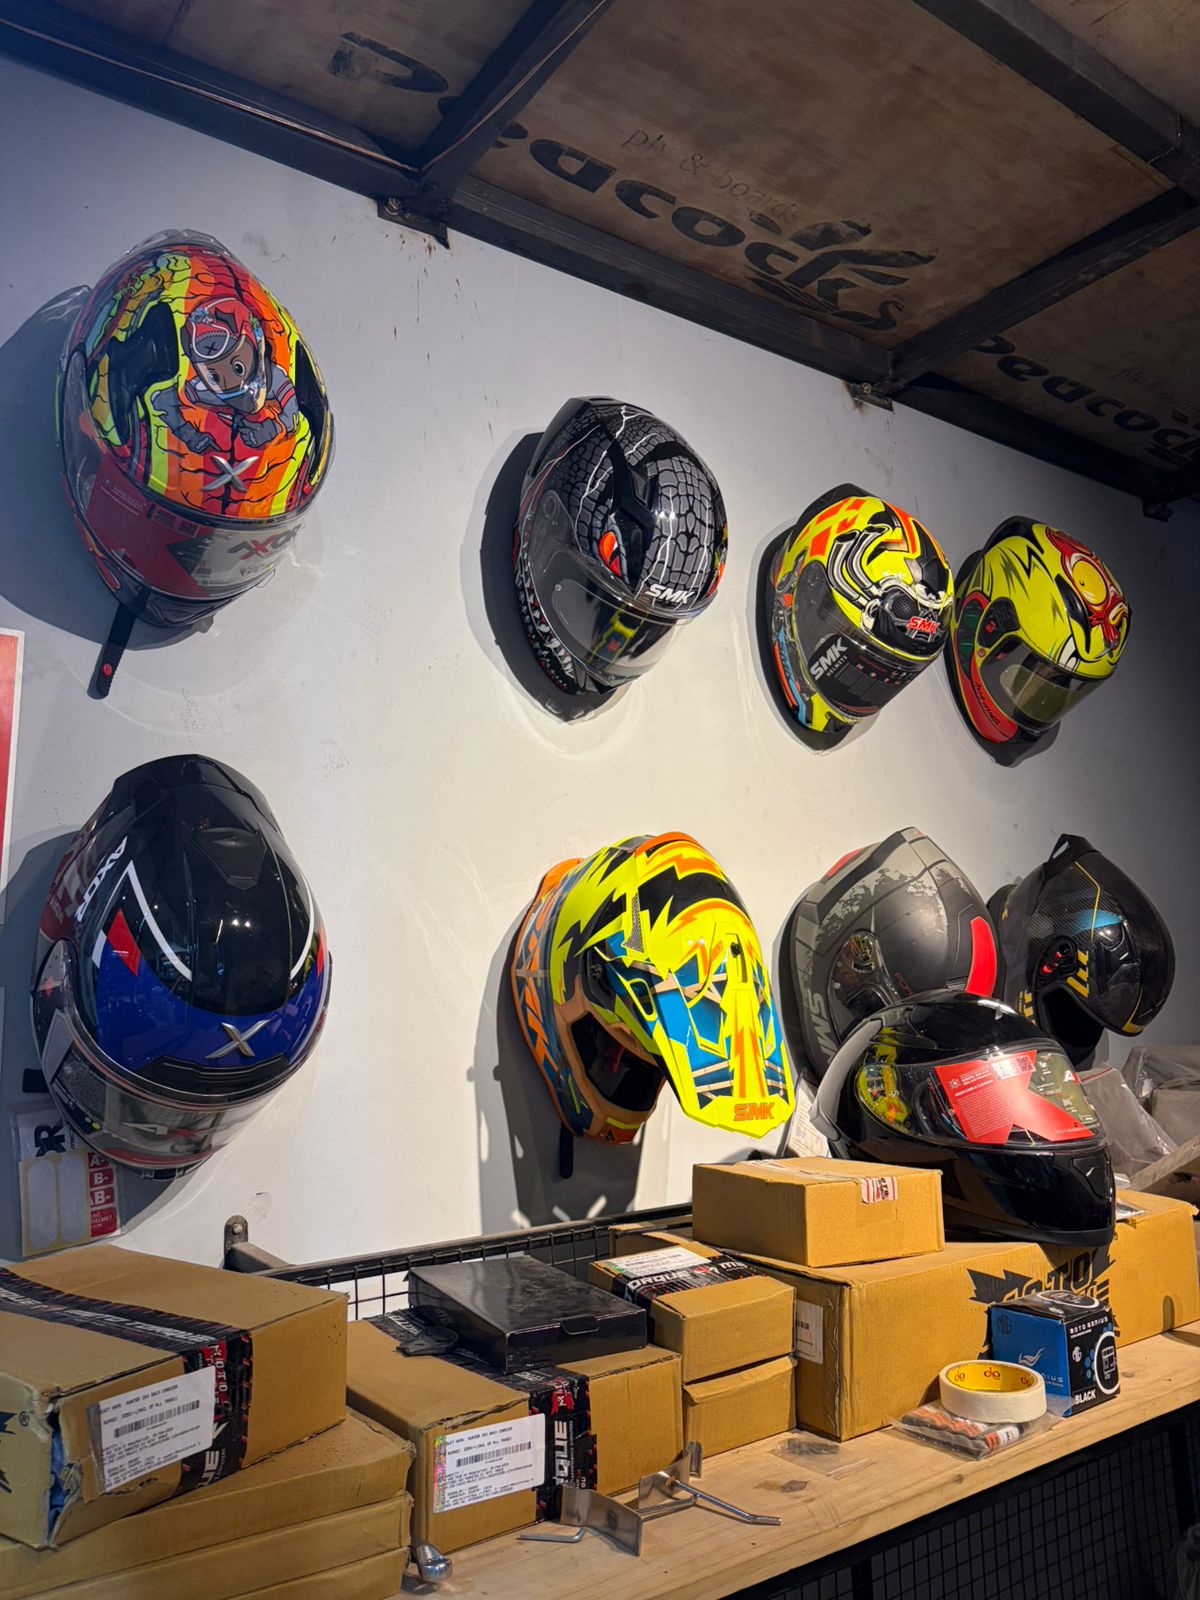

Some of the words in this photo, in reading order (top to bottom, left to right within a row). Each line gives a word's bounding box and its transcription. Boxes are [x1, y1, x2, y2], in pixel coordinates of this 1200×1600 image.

[648, 583, 695, 605] SMK
[906, 615, 941, 634] SMK
[809, 636, 849, 682] SMK
[732, 1101, 775, 1122] SMK
[1074, 1389, 1097, 1405] BLACK
